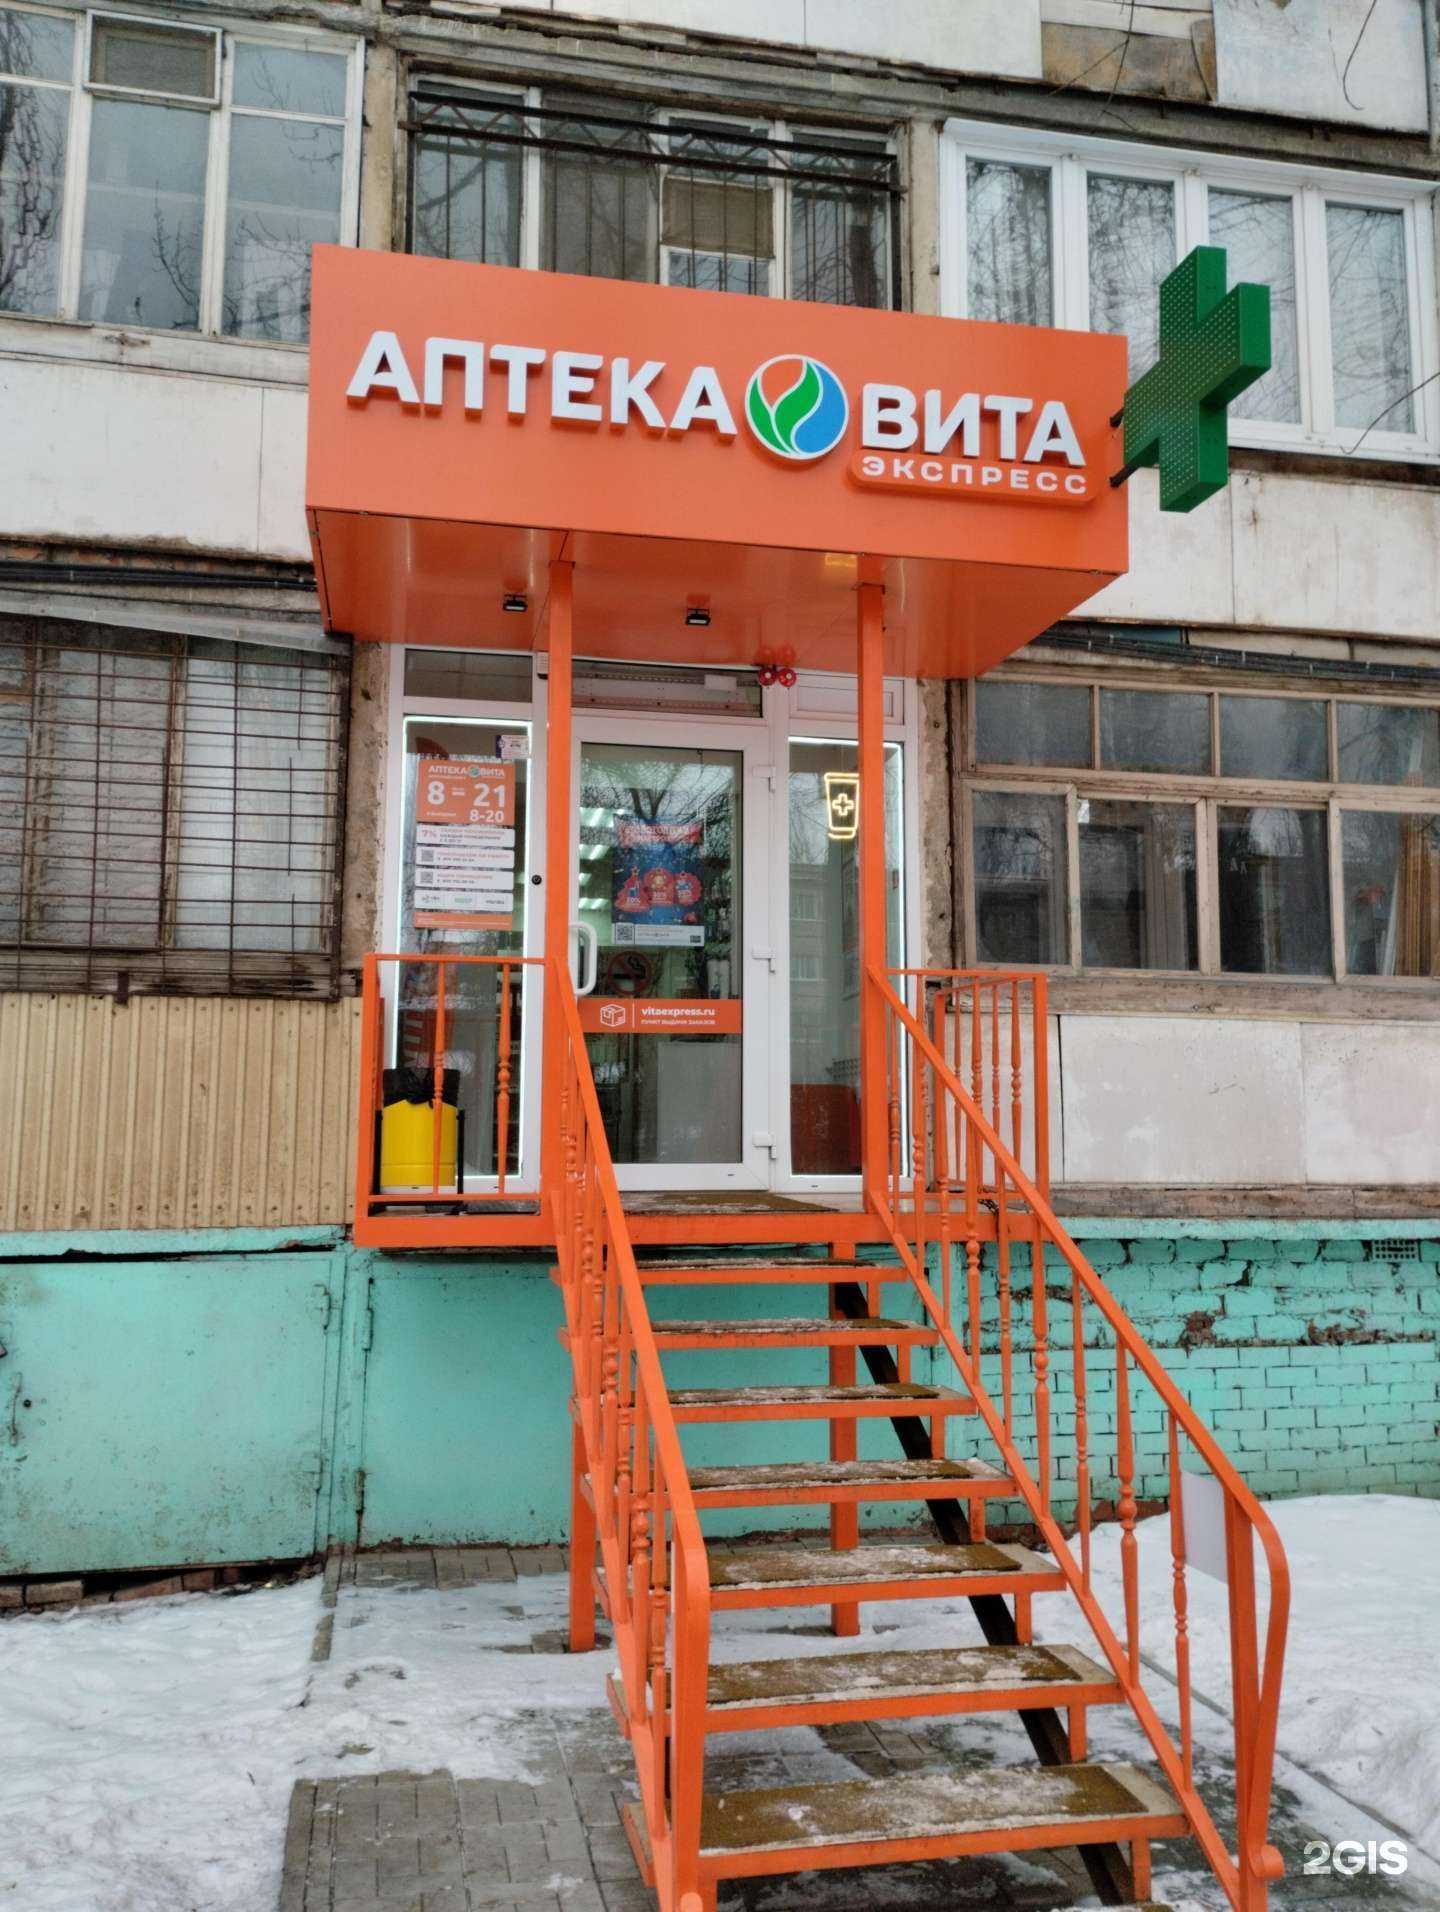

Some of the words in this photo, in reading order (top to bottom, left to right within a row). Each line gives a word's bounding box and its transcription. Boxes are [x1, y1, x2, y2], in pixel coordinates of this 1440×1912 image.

[346, 330, 738, 438] АПТЕКА
[861, 382, 1087, 467] ВИТА
[861, 455, 1088, 495] ЭКСПРЕСС
[428, 765, 467, 776] АПТЕКА
[480, 767, 505, 777] ВИТА
[427, 780, 446, 806] 8
[472, 782, 506, 808] 21
[469, 808, 505, 824] 8-20
[641, 1006, 716, 1018] vitaexpress.ru
